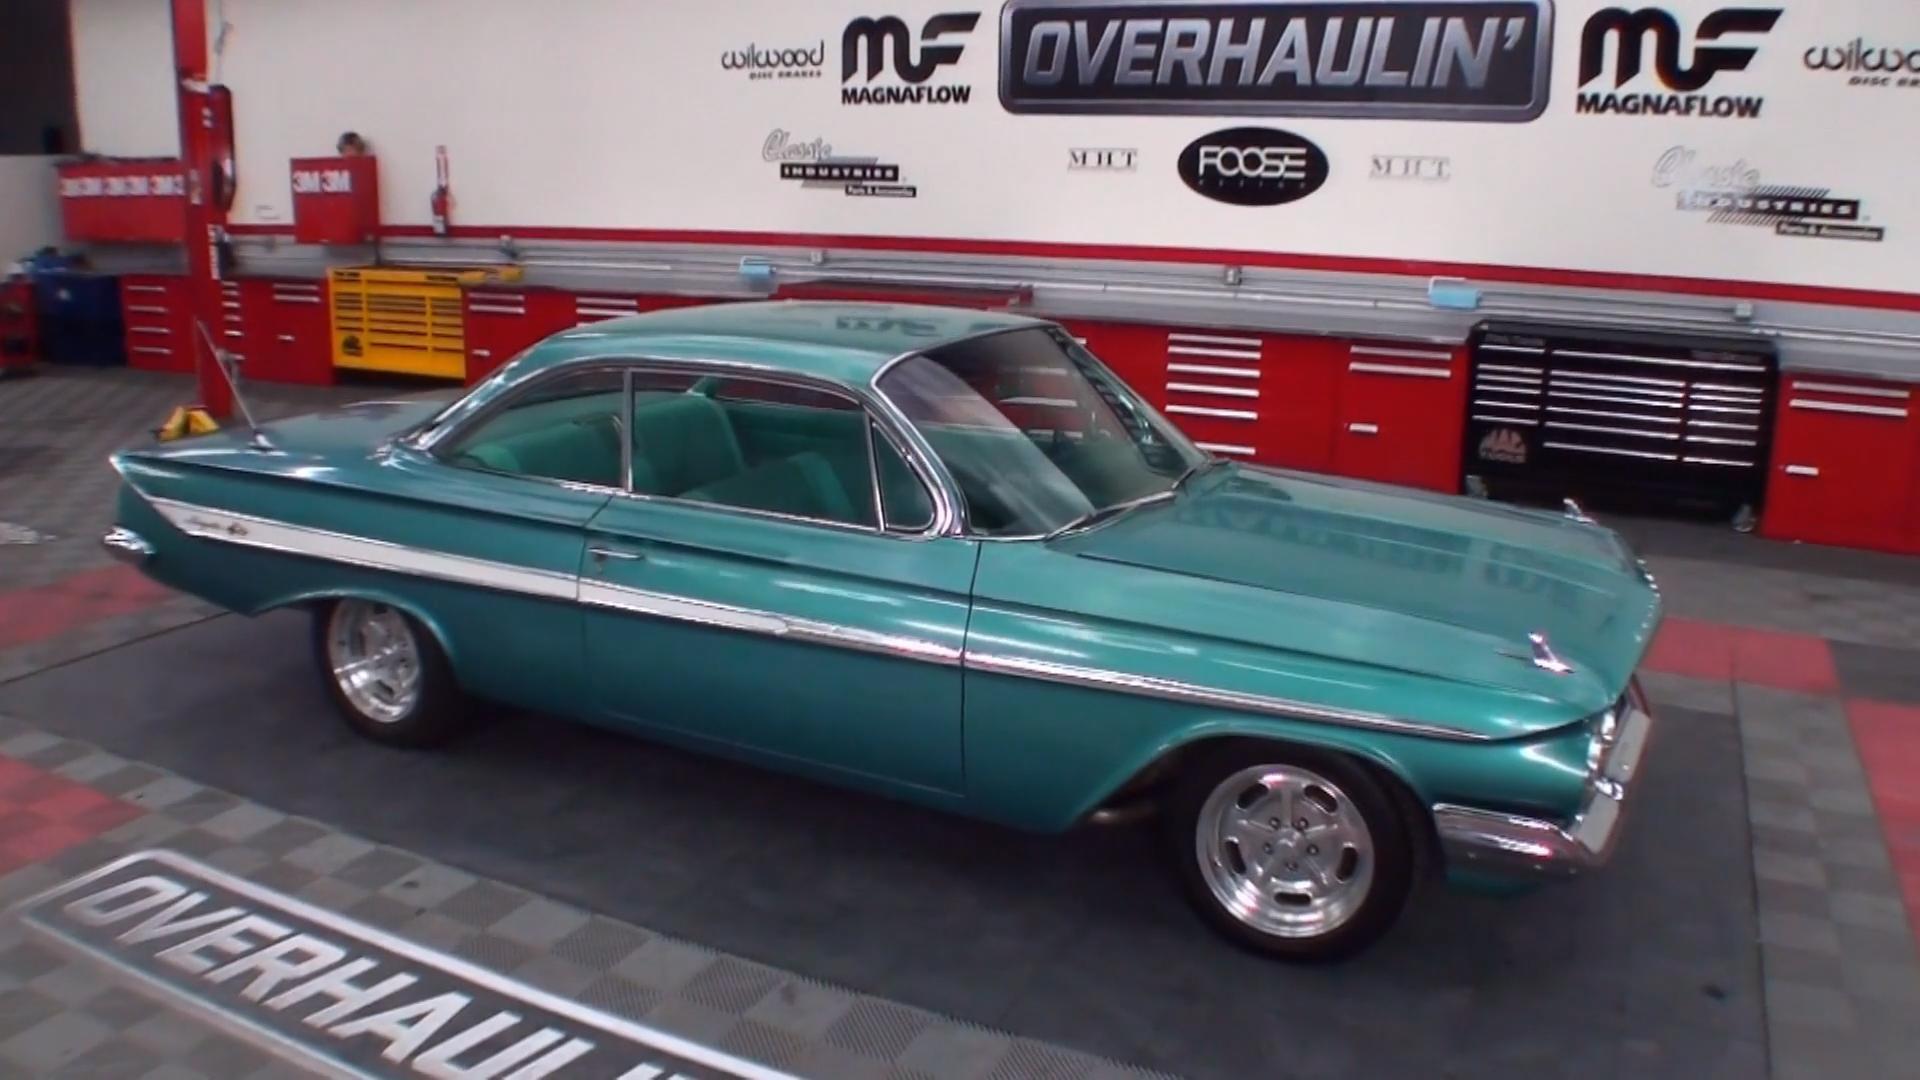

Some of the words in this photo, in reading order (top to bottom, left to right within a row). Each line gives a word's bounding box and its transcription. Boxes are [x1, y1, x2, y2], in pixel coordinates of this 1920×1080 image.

[721, 39, 824, 70] wilwood
[841, 85, 971, 105] MAGNAFLOW
[1576, 93, 1763, 118] MAGNAFLOW
[1199, 145, 1307, 178] FOOSE
[293, 170, 319, 193] 3M
[321, 169, 352, 193] 3M
